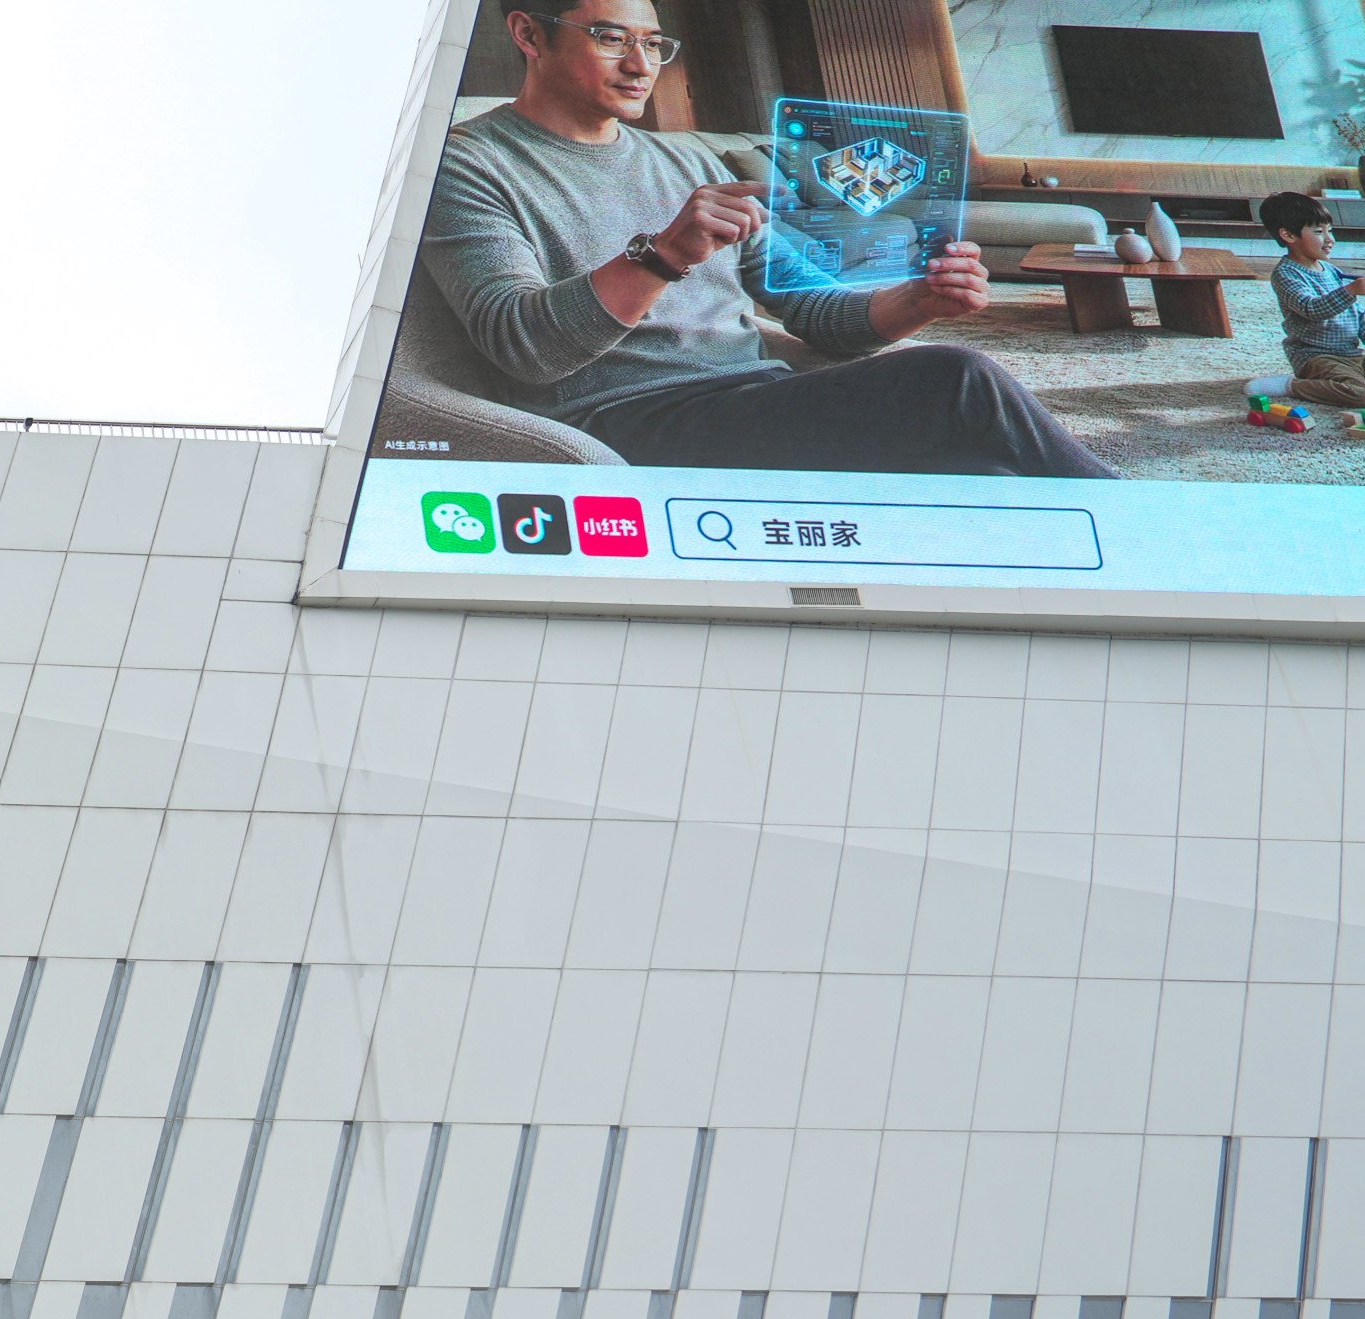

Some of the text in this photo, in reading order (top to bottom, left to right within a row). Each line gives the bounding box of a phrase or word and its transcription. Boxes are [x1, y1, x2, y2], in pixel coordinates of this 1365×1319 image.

[384, 440, 450, 451] AI生成示意图
[583, 518, 639, 537] 小红书
[762, 519, 861, 547] 宝丽家
